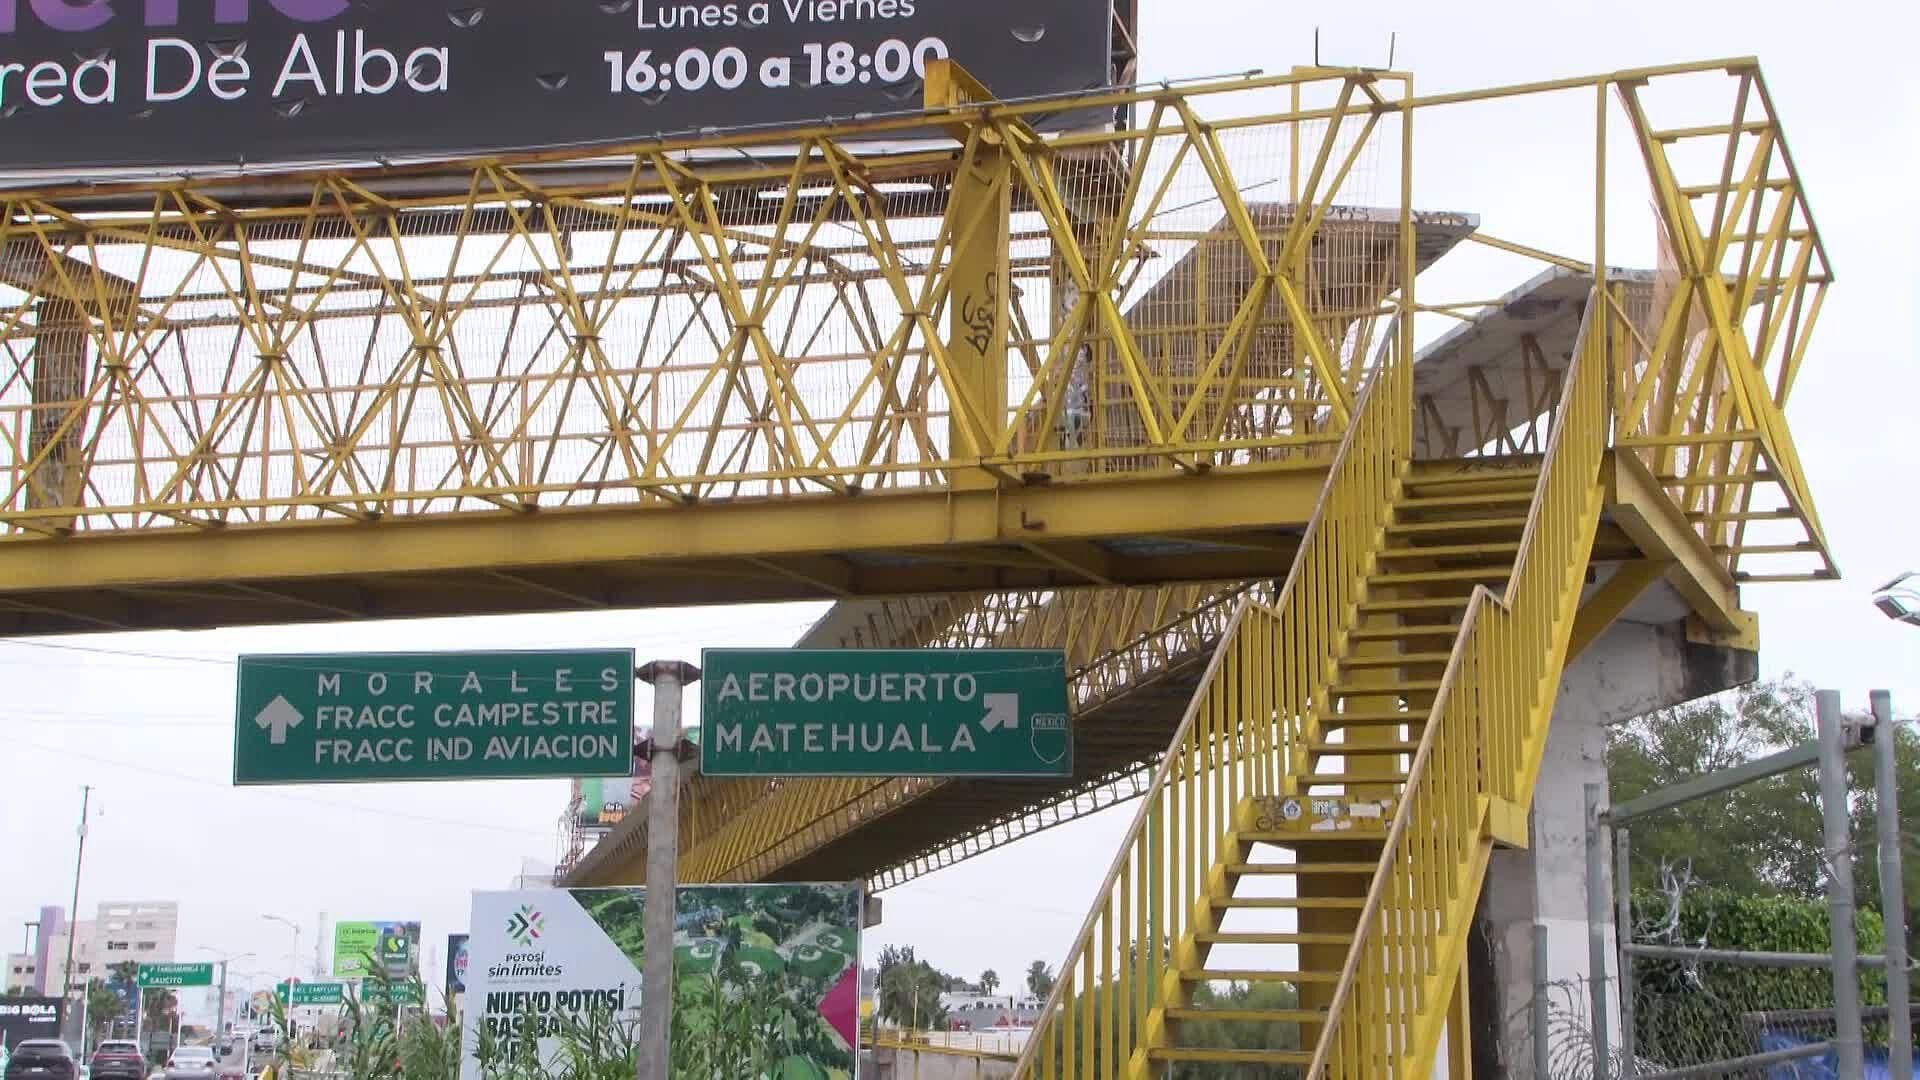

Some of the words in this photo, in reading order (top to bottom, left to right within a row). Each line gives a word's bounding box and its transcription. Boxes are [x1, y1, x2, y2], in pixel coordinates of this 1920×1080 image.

[637, 0, 738, 29] Lunes
[748, 2, 769, 24] a
[783, 0, 915, 23] Viernes
[146, 38, 250, 101] De
[272, 29, 449, 97] Alba
[604, 47, 748, 93] 16:00
[759, 57, 791, 88] a
[718, 672, 977, 702] AEROPUERTO
[316, 705, 415, 729] FRACC
[434, 701, 618, 726] CAMPESTRE
[315, 739, 413, 763] FRACC
[427, 737, 473, 761] IND
[484, 735, 618, 760] AVIACION
[716, 723, 976, 752] MATEHUALA
[488, 963, 510, 977] sin
[486, 990, 551, 1014] NUEVO
[555, 983, 625, 1012] POTOSÍ
